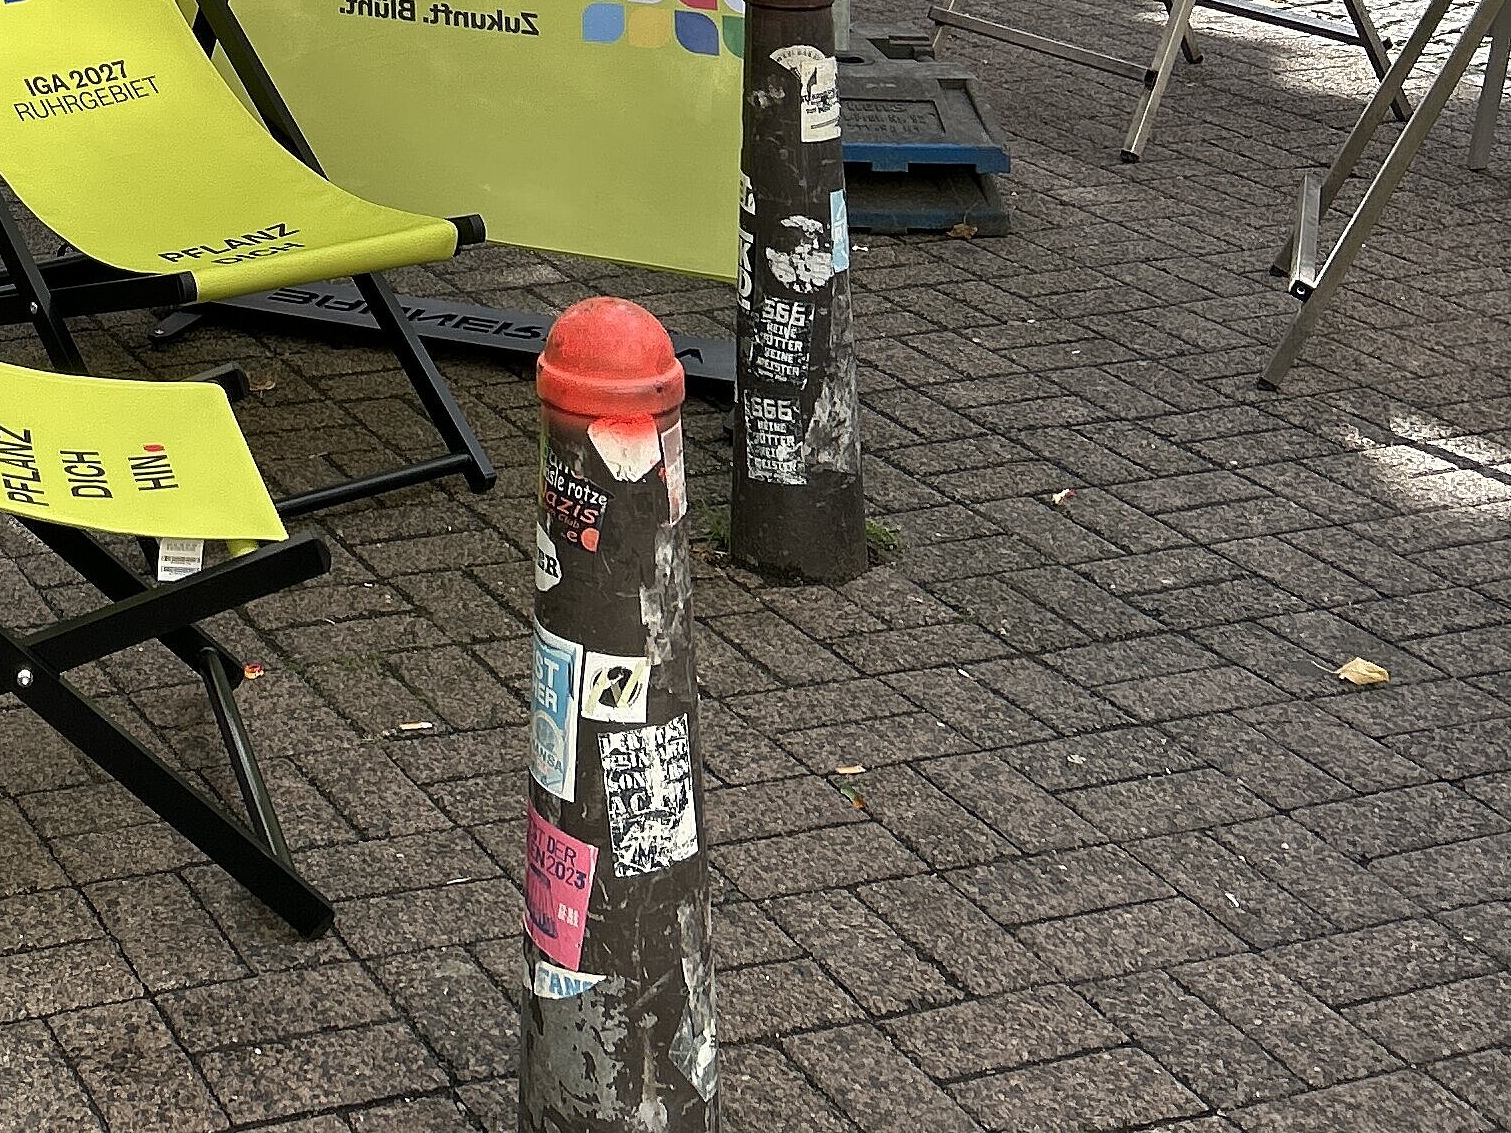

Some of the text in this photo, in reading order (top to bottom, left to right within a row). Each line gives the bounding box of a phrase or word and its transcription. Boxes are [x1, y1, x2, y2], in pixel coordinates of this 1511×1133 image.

[13, 74, 161, 122] RUHRGEBIET
[24, 59, 127, 97] IGA 2027
[158, 222, 301, 264] PFLANZ
[60, 450, 113, 499] DICH
[547, 835, 577, 868] DER
[546, 854, 587, 890] 2023
